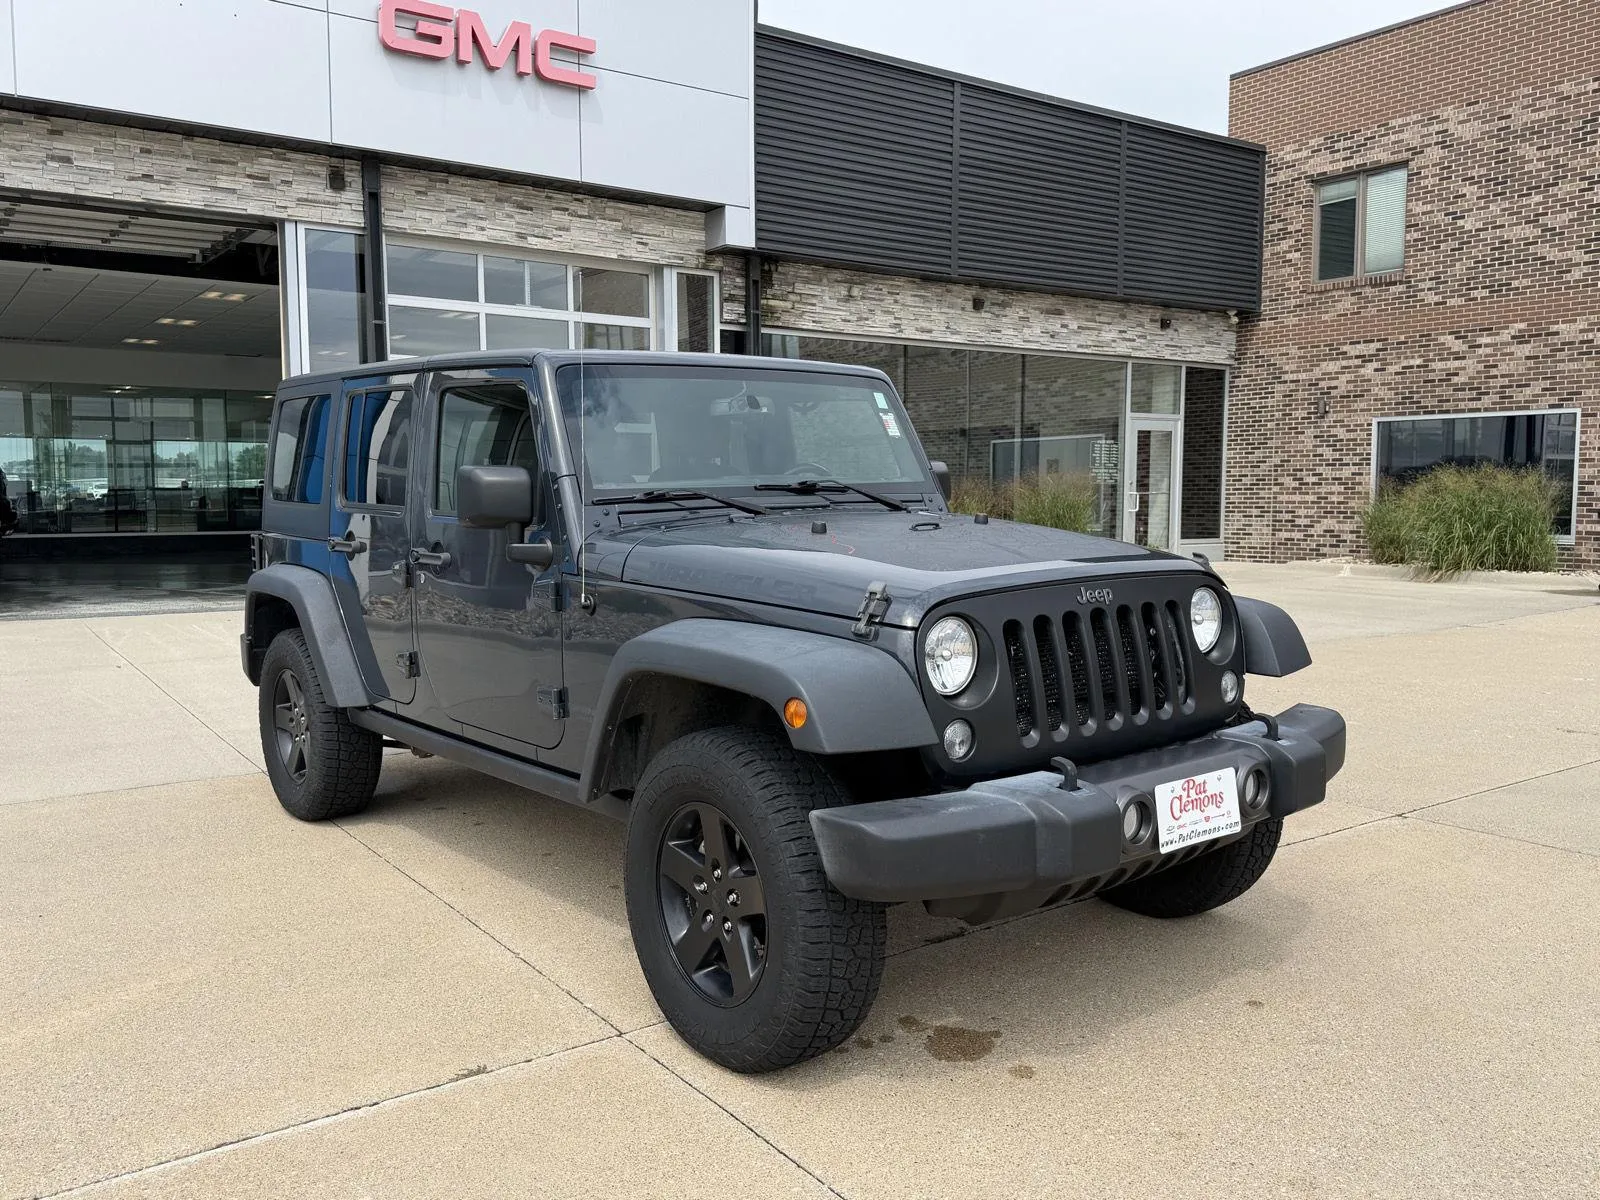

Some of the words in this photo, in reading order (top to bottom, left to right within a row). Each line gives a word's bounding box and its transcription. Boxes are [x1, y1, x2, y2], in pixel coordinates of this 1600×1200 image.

[379, 0, 597, 90] GMC
[1076, 586, 1113, 605] Jeep
[1181, 778, 1208, 798] Pat
[1170, 790, 1224, 821] Clemons
[1160, 820, 1240, 849] www.PatClemons.com
